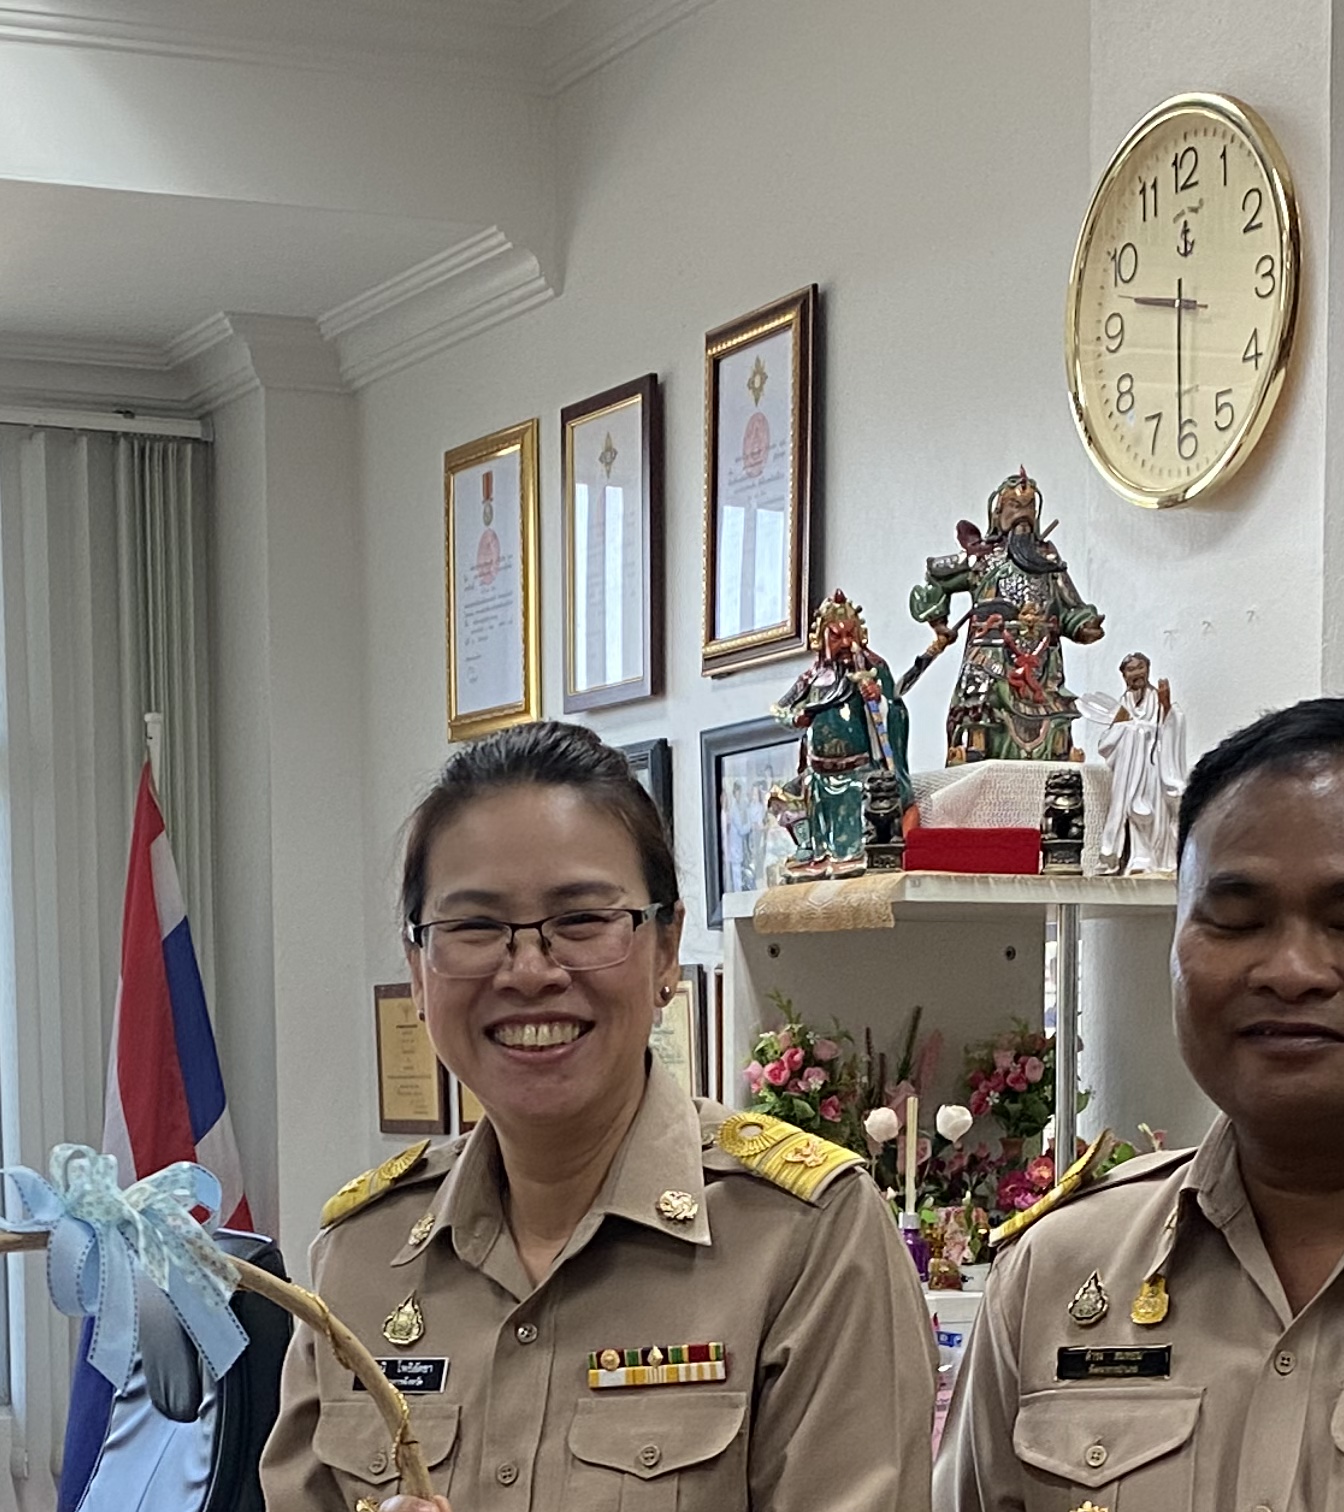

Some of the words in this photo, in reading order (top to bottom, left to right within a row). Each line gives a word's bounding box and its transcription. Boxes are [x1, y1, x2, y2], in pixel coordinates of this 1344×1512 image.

[1171, 145, 1200, 195] 12
[1218, 144, 1229, 187] 1
[1138, 175, 1160, 222] 11
[1242, 188, 1264, 234] 2
[1109, 242, 1138, 288] 10
[1254, 254, 1277, 299] 3
[1104, 312, 1126, 354] 9
[1242, 328, 1264, 371] 4
[1115, 373, 1136, 415] 8
[1214, 388, 1235, 433] 5
[1144, 412, 1163, 457] 7
[1178, 418, 1199, 461] 6
